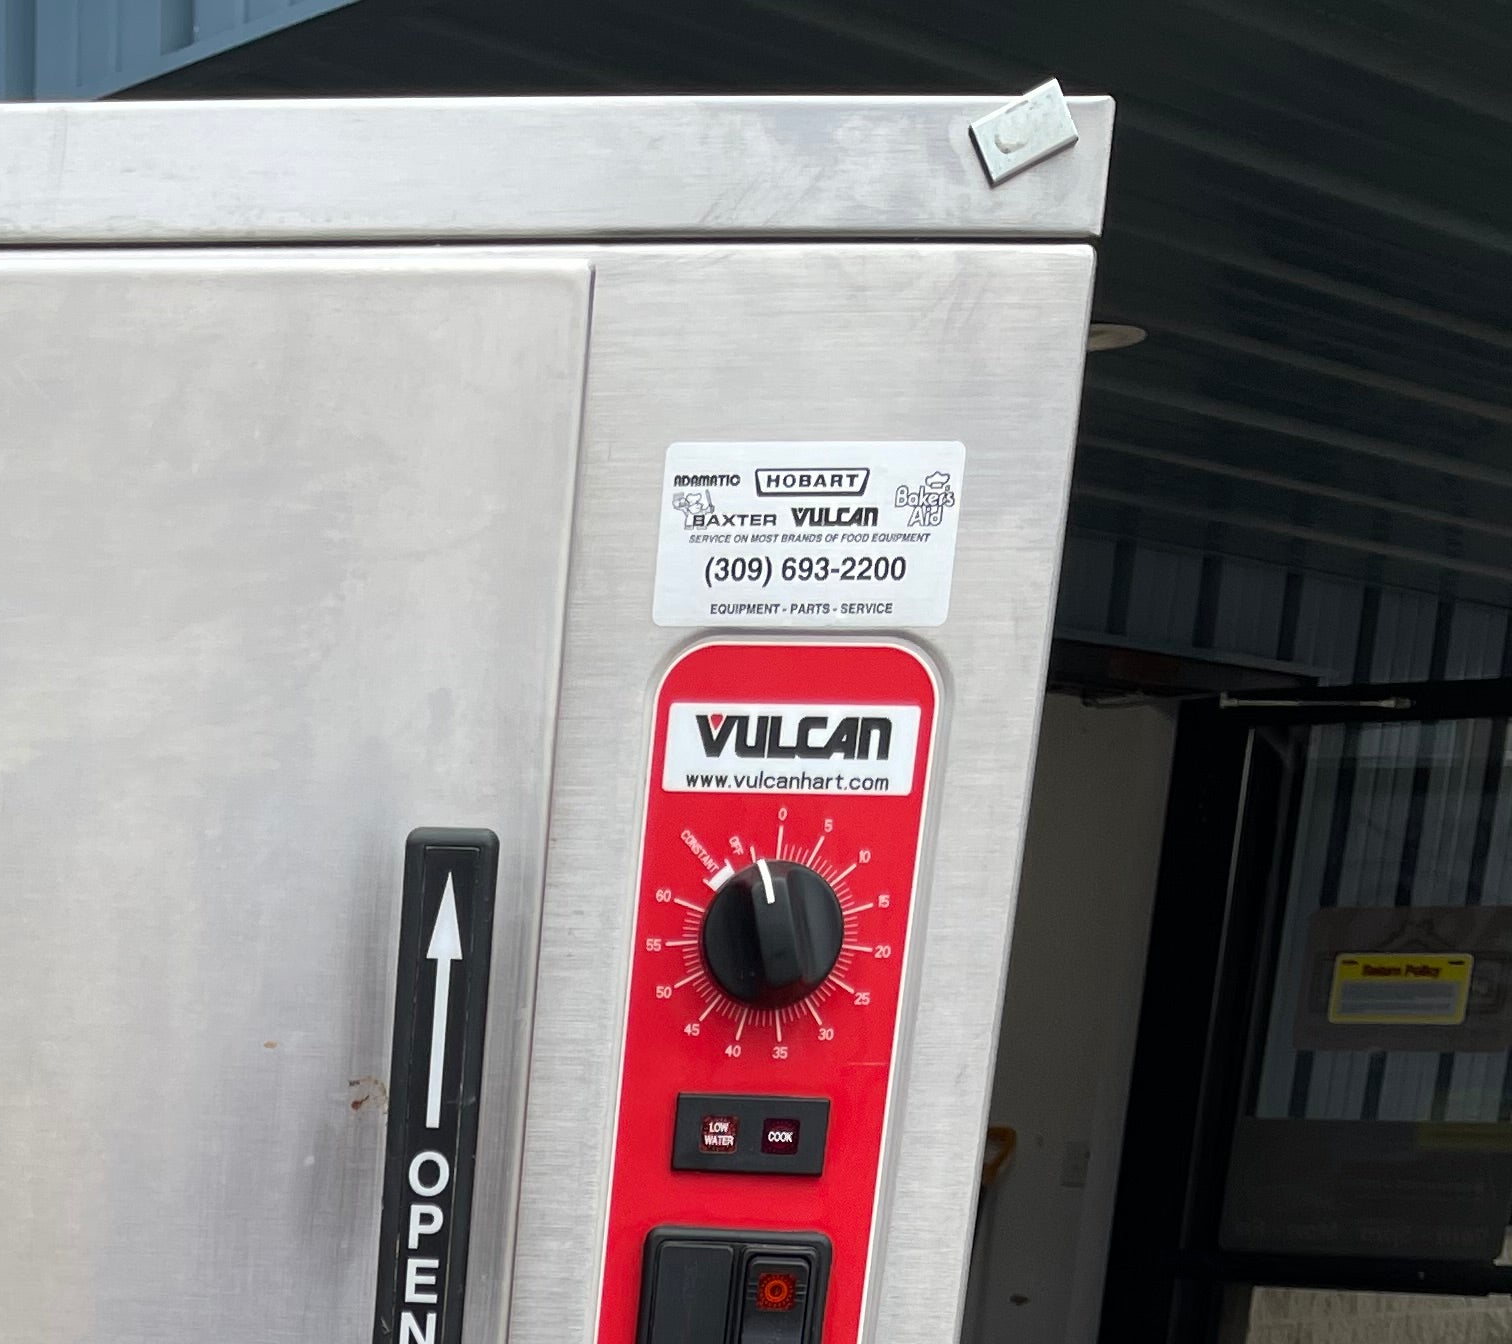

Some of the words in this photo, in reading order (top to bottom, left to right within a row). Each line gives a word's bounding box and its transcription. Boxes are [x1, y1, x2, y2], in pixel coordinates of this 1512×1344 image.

[766, 474, 859, 488] HOBART
[692, 514, 777, 526] BAXTER
[791, 507, 879, 526] VULCAN
[908, 507, 943, 526] Aid
[689, 534, 731, 544] SERVICE
[733, 534, 748, 543] ON
[750, 534, 779, 543] MOST
[781, 533, 822, 543] BRANDS
[824, 533, 838, 543] OF
[840, 533, 869, 543] FOOD
[871, 533, 931, 543] EQUIPMENT
[705, 557, 772, 588] (309)
[781, 556, 907, 581] 693-2200
[710, 603, 780, 615] EQUIPMENT
[790, 603, 830, 614] PARTS
[841, 603, 893, 614] SERVICE
[695, 714, 892, 760] VULCAN
[686, 771, 889, 792] www.vulcanhart.com
[778, 808, 788, 820] 0
[824, 819, 833, 833] 5
[680, 830, 719, 874] CONSTANT
[728, 835, 744, 856] OFF
[858, 850, 871, 863] 10
[656, 889, 672, 902] 60
[878, 895, 890, 907] 15
[646, 939, 662, 951] 55
[875, 945, 892, 958] 20
[656, 986, 672, 999] 50
[854, 992, 871, 1005] 25
[684, 1024, 701, 1036] 45
[818, 1028, 834, 1041] 30
[725, 1045, 742, 1058] 40
[772, 1047, 788, 1060] 35
[709, 1122, 730, 1133] LOW
[704, 1135, 734, 1146] WATER
[768, 1131, 793, 1143] COOK
